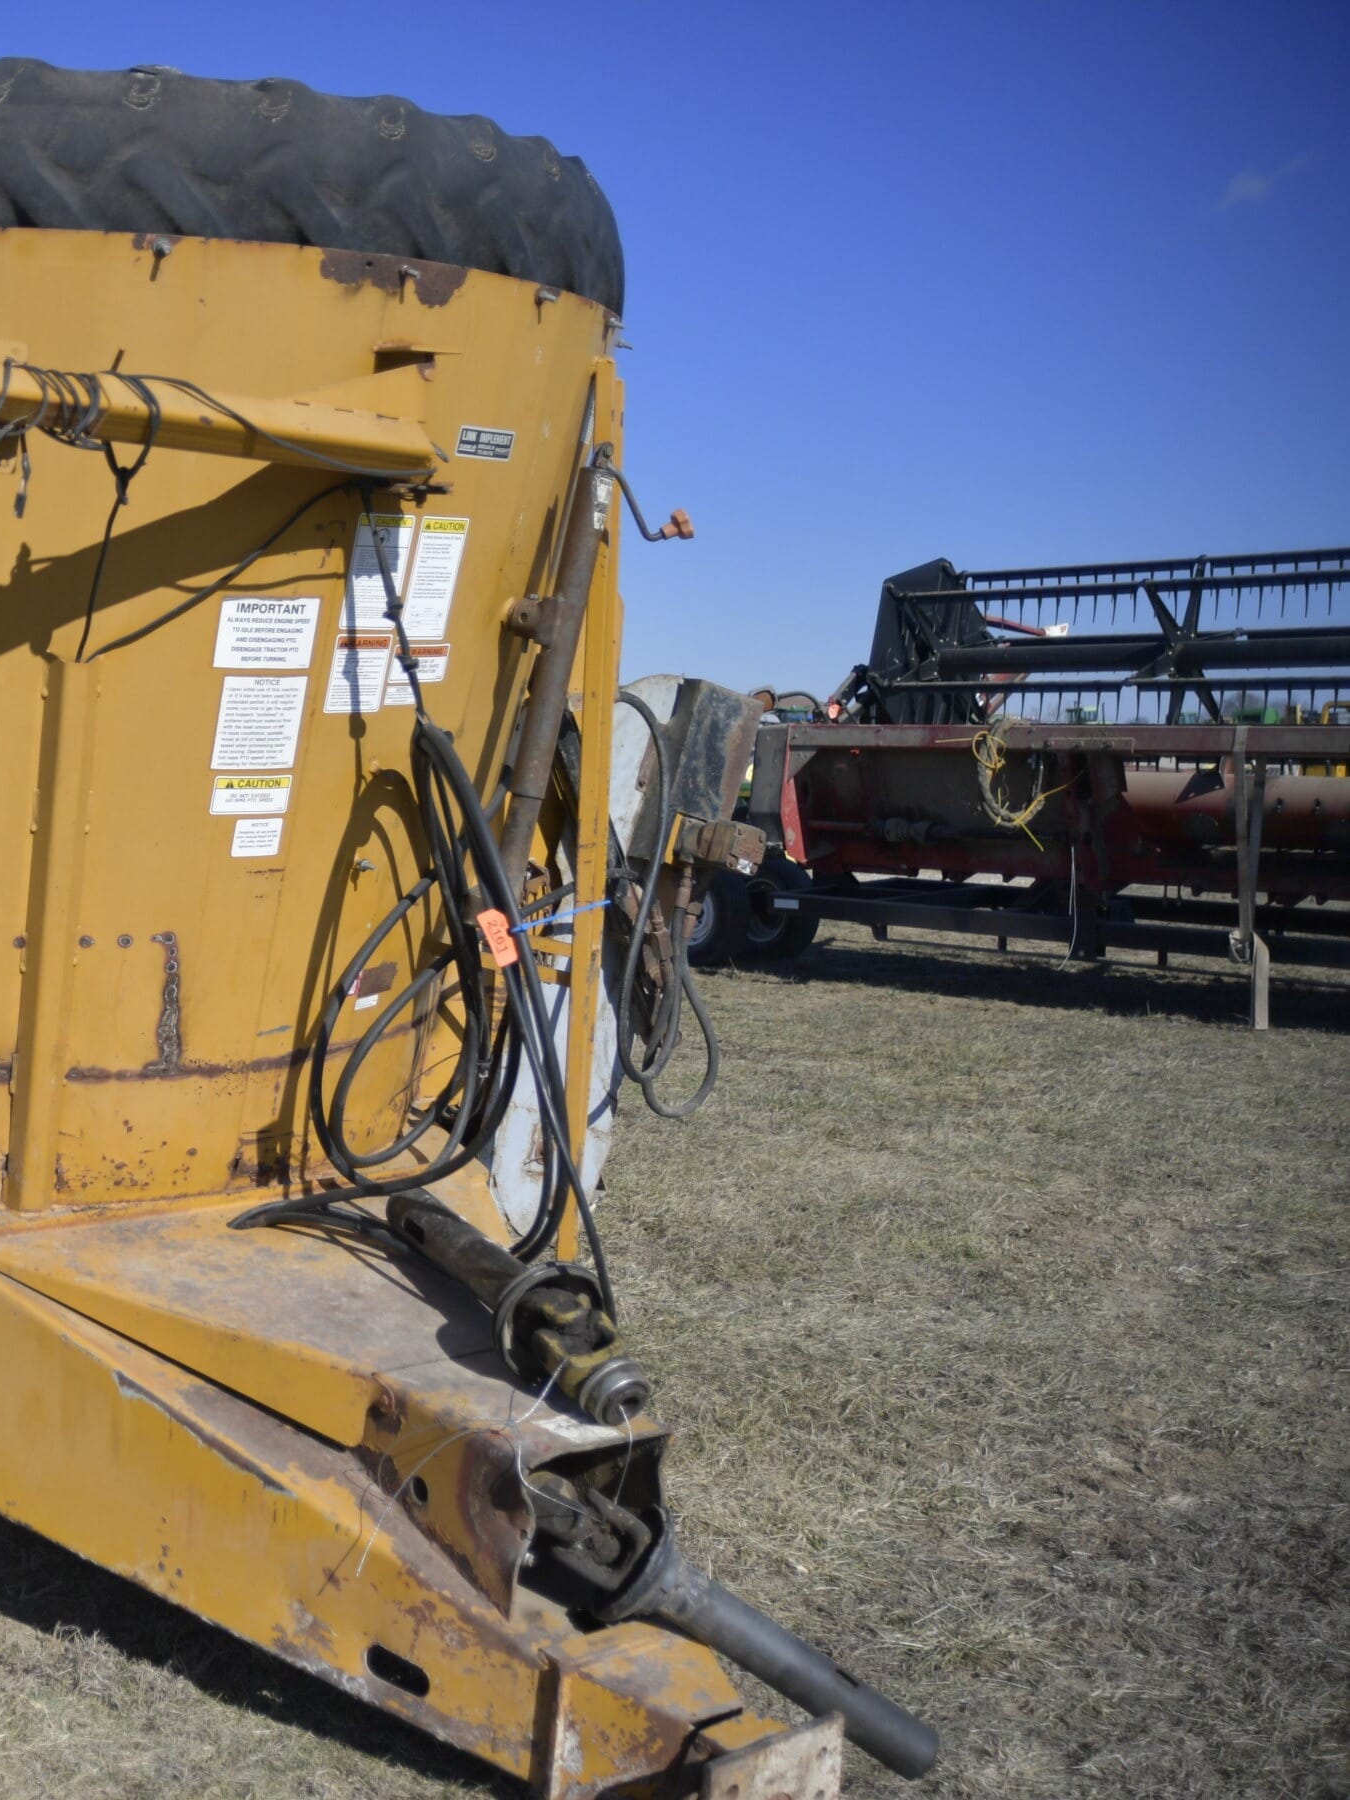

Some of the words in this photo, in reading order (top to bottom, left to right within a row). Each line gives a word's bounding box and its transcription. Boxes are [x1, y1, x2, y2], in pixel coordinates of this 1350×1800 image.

[462, 430, 479, 442] LINK
[479, 432, 512, 447] IMPLEMENT
[432, 521, 466, 531] CAUTION
[237, 603, 306, 614] IMPORTANT
[237, 779, 281, 787] CAUTION
